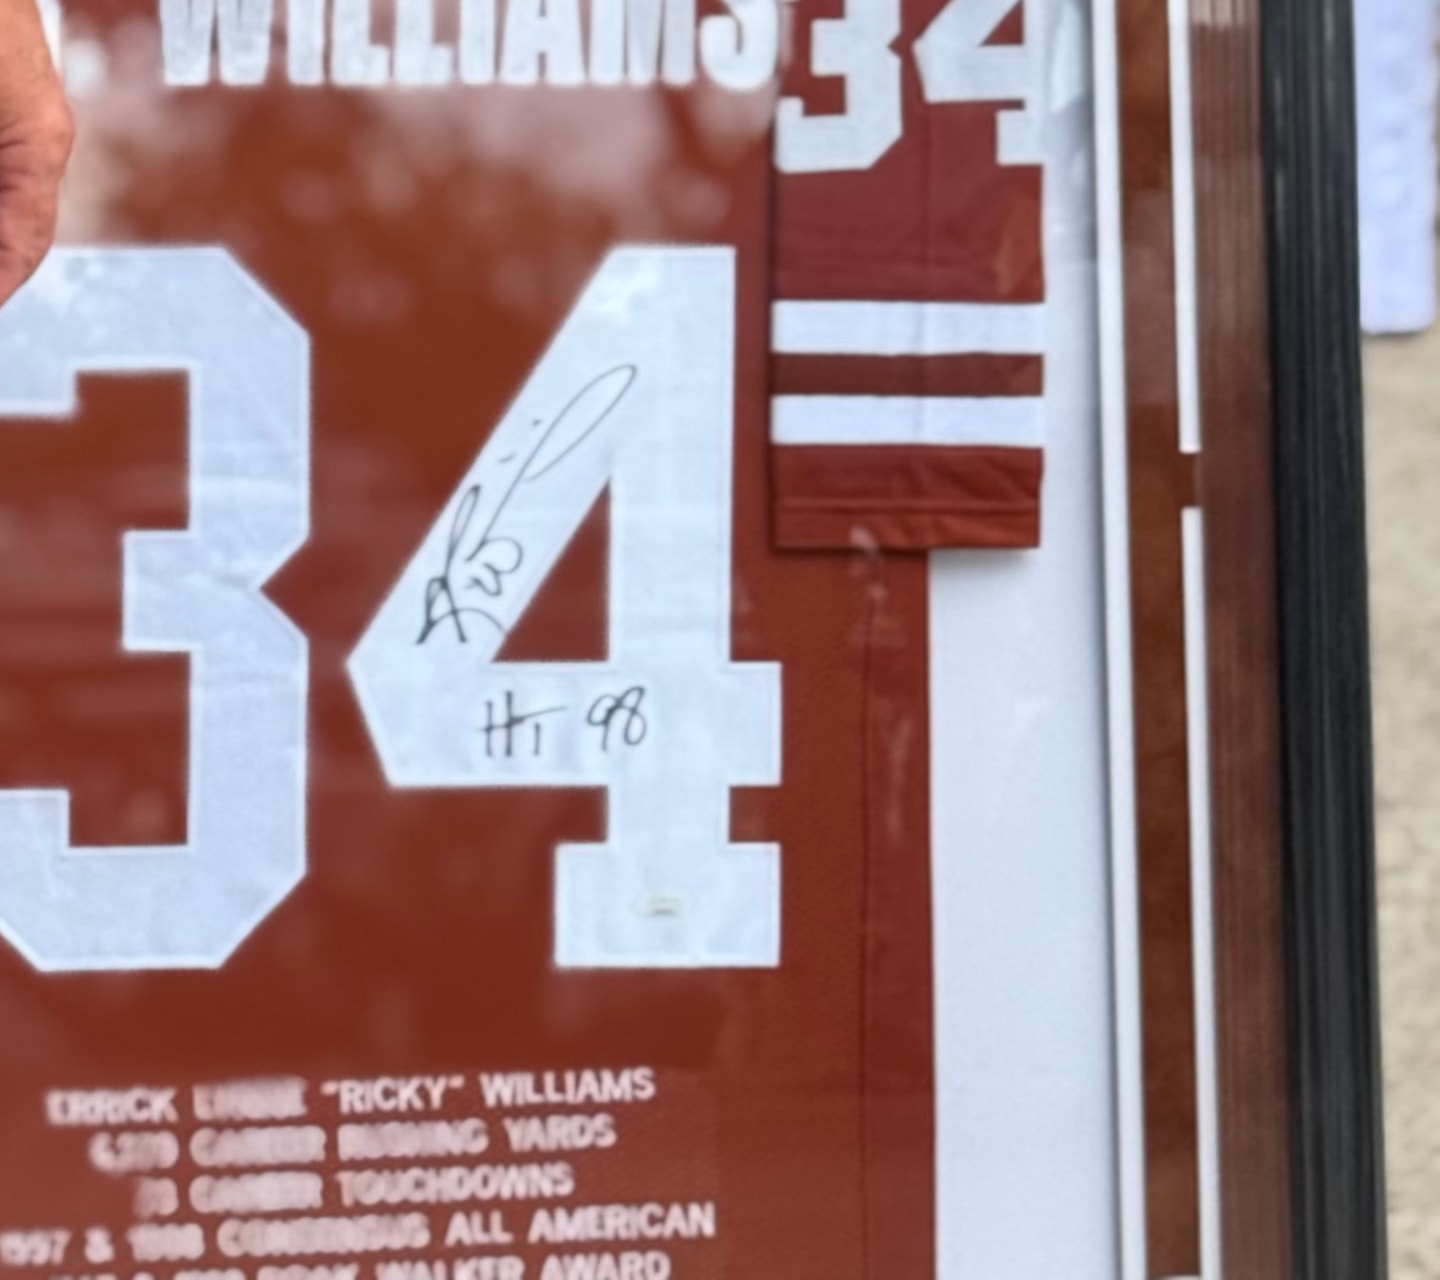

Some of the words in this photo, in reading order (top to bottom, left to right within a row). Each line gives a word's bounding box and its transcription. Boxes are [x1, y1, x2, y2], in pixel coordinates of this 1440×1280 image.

[479, 1066, 656, 1108] WILLIAMS
[502, 1113, 618, 1152] YARDS
[335, 1161, 575, 1207] TOUCHDOWNS
[445, 1209, 514, 1247] ALL
[528, 1201, 716, 1244] AMERICAN
